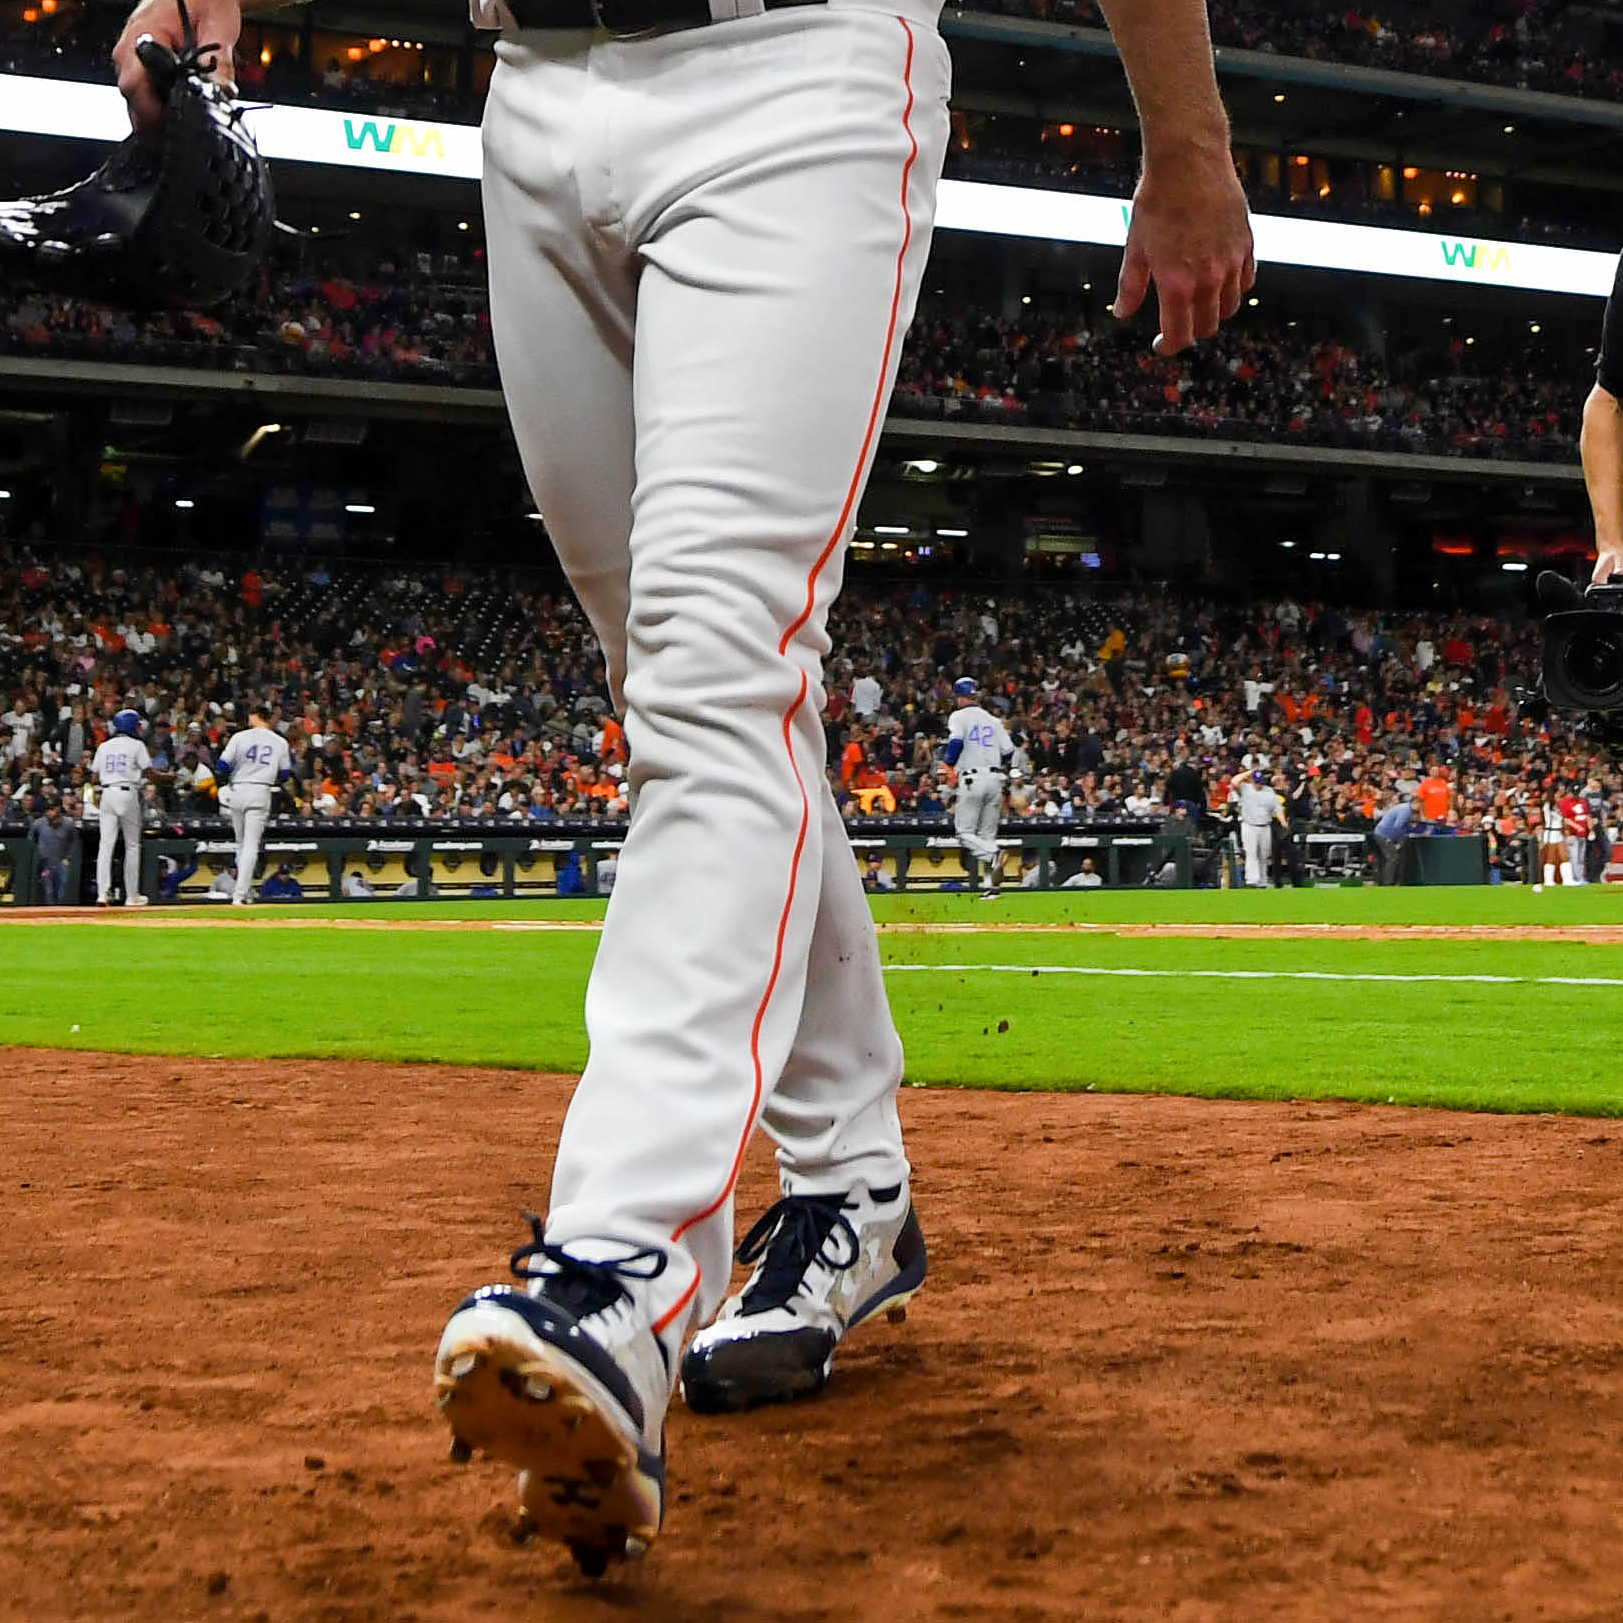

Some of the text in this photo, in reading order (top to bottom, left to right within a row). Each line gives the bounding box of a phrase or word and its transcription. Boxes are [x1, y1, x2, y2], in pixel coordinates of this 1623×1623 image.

[344, 119, 444, 159] WM
[1441, 241, 1512, 270] WM
[968, 724, 994, 748] 42
[245, 744, 274, 765] 42
